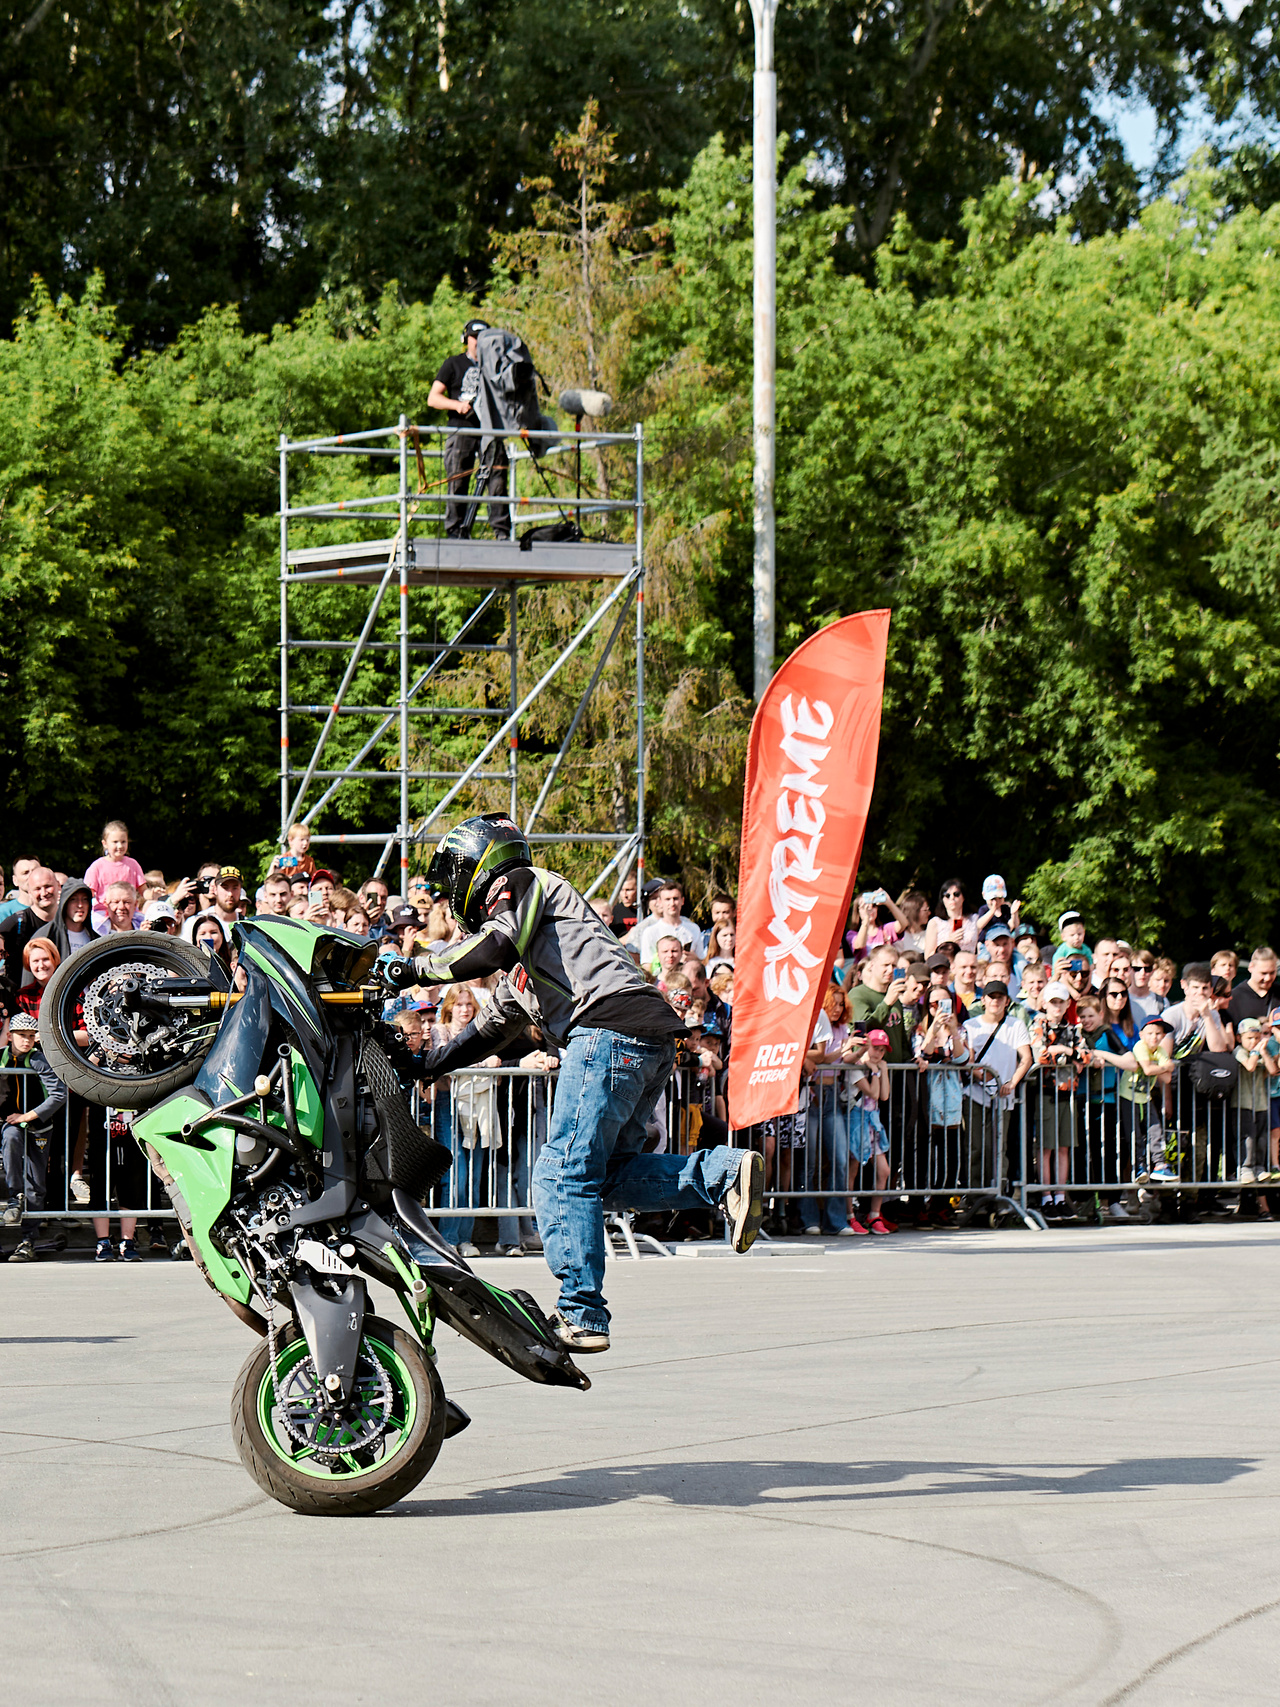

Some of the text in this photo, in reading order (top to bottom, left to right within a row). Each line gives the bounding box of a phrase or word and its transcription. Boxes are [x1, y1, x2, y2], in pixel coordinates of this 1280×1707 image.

[763, 692, 835, 1006] EXTREME
[754, 1042, 800, 1068] RCC
[748, 1067, 791, 1087] EXTREME
